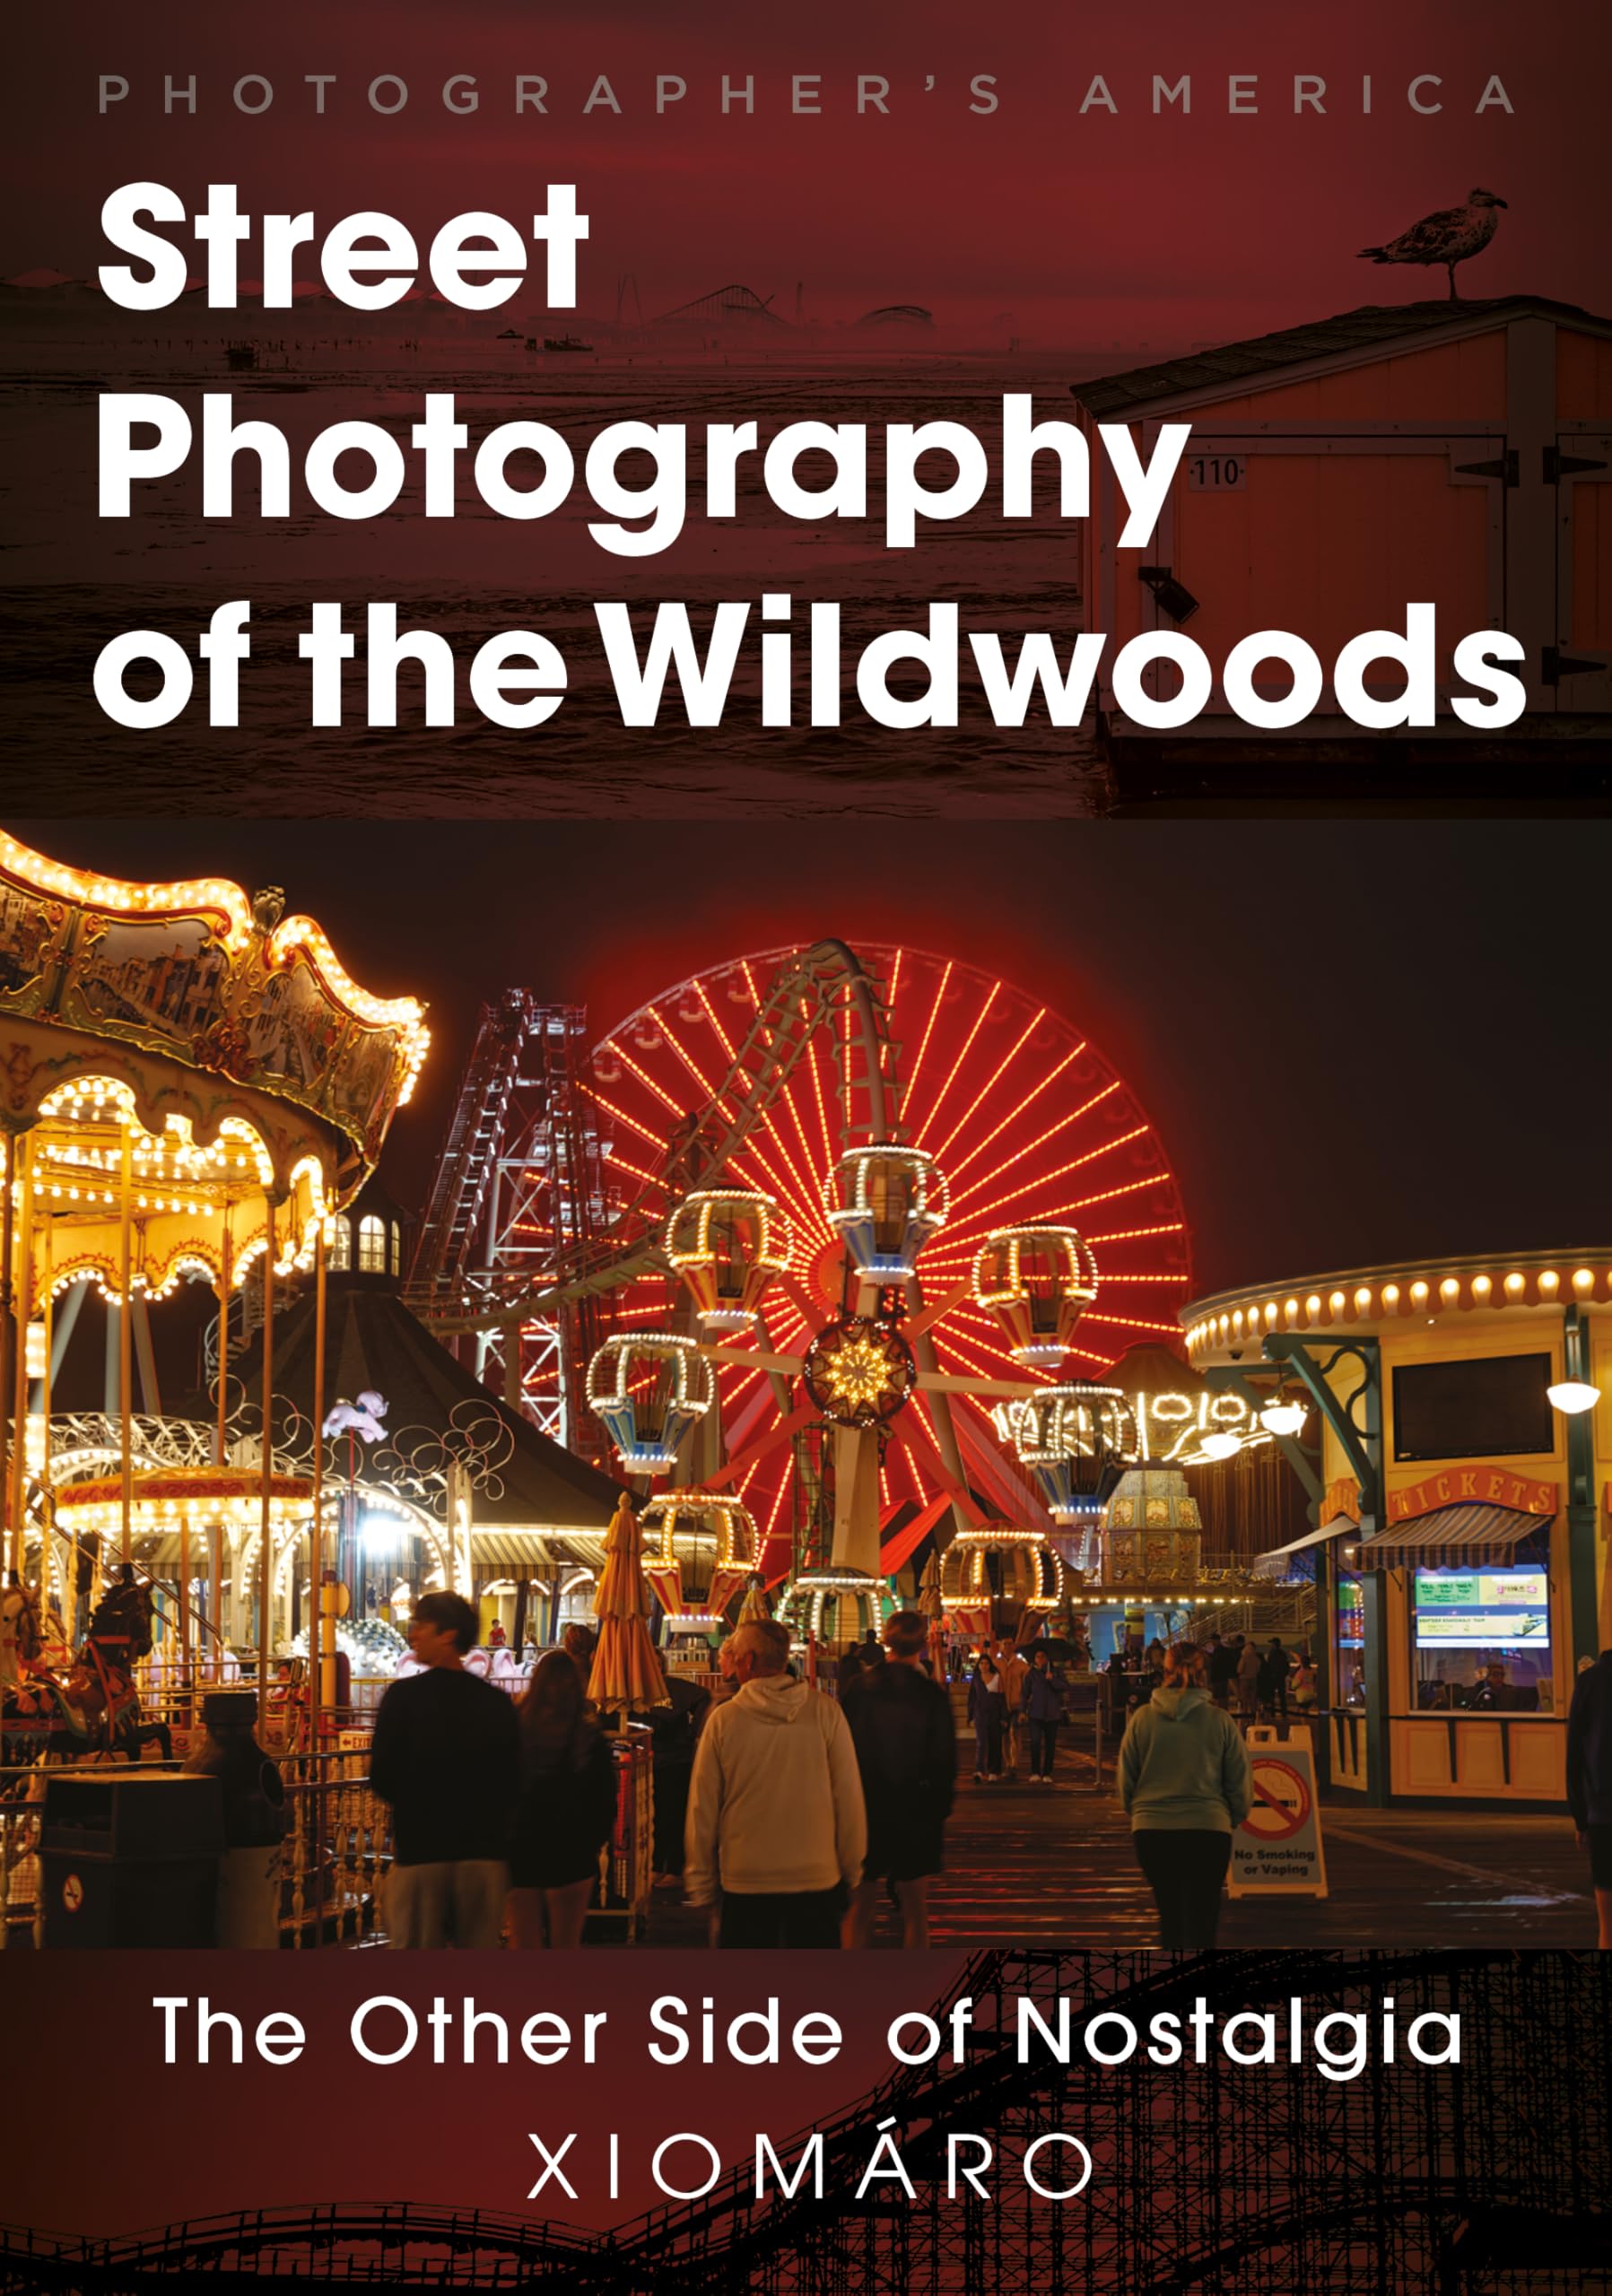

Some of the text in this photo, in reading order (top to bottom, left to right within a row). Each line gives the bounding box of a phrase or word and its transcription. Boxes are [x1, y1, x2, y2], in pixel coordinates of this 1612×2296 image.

[1194, 458, 1238, 485] 110
[1392, 1472, 1551, 1516] TICKETS
[1234, 1849, 1315, 1862] No Smoking
[1243, 1865, 1309, 1876] or Vaping
